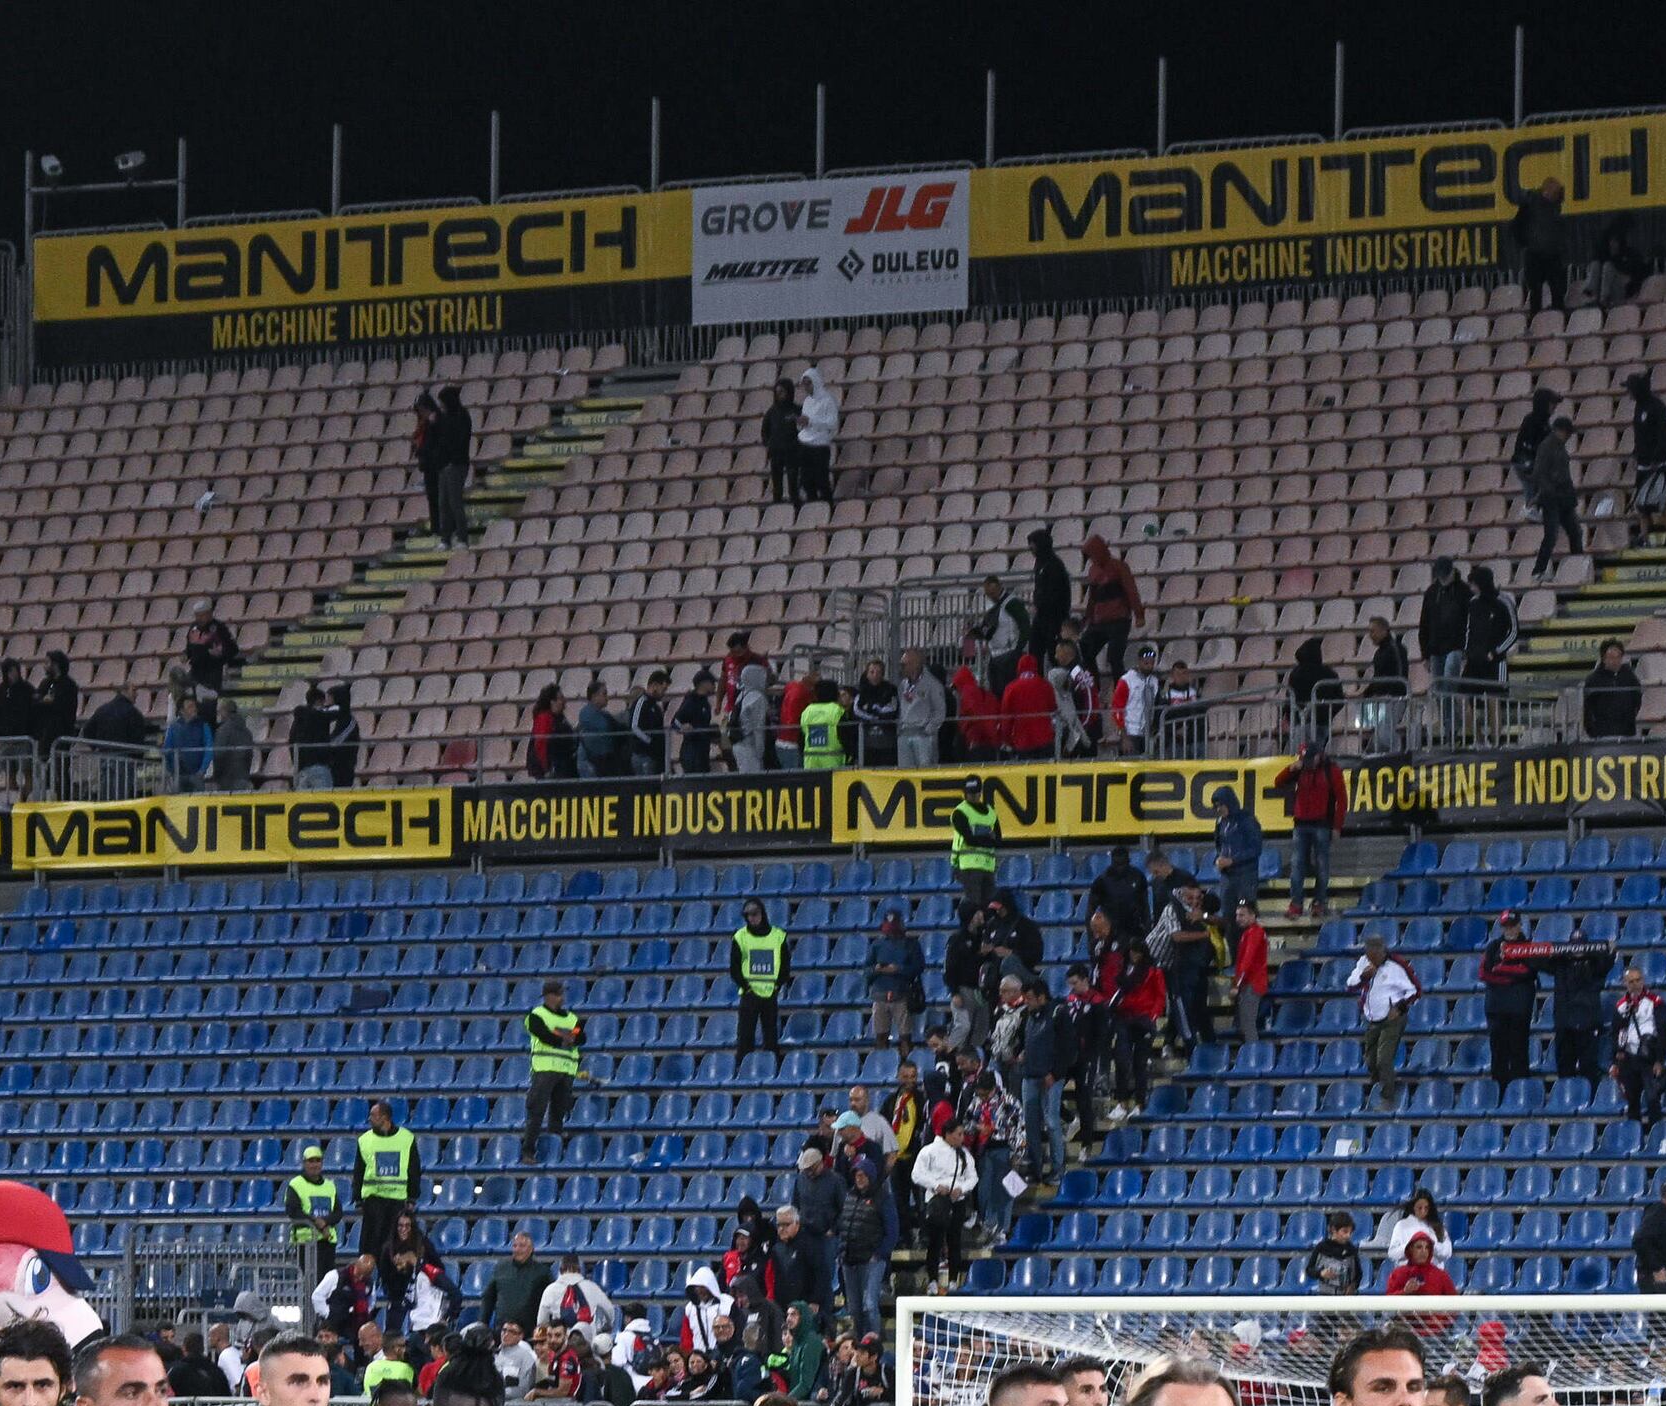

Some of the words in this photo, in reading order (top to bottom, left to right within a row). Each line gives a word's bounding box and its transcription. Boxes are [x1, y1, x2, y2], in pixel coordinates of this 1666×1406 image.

[700, 199, 832, 236] GROVE
[844, 181, 957, 235] JLG
[705, 256, 821, 282] MULTITEL
[872, 248, 960, 274] DULEVO
[1170, 242, 1313, 288] MACCHINE
[1324, 225, 1499, 276] INDUSTRIALI
[211, 305, 339, 352] MACCHINE
[349, 293, 504, 342] INDUSTRIALI
[463, 795, 618, 843] MACCHINE
[633, 785, 822, 837] INDUSTRIALI
